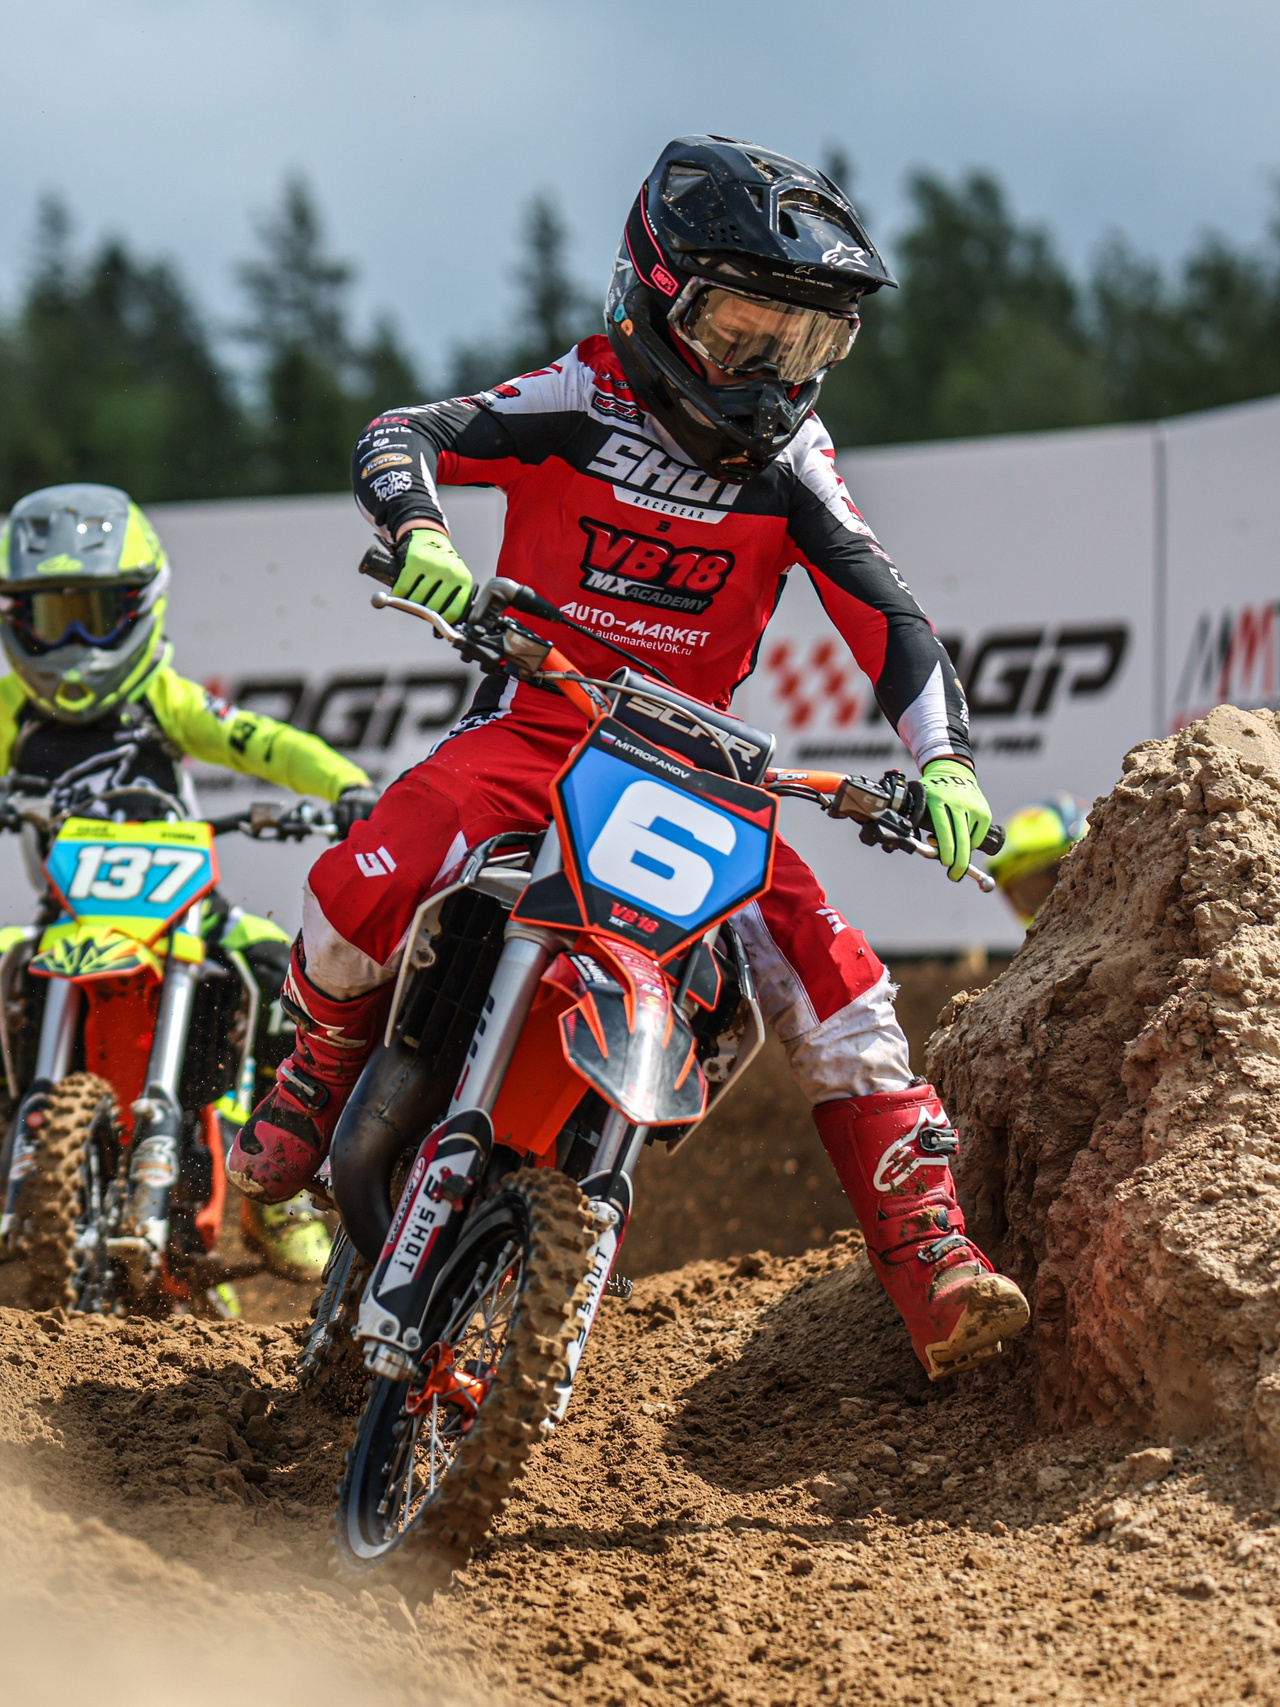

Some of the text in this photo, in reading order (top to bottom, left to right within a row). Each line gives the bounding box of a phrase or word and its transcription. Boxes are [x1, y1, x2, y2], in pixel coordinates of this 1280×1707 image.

[654, 270, 675, 291] 100%
[633, 495, 706, 520] RACEGEAR
[559, 601, 711, 647] AUTO-MARKET
[625, 695, 761, 765] SCAR
[614, 739, 691, 779] MITROFANOV
[777, 772, 809, 781] SCAR
[587, 779, 737, 917] 6
[68, 845, 206, 903] 137
[399, 1208, 437, 1274] SHOT
